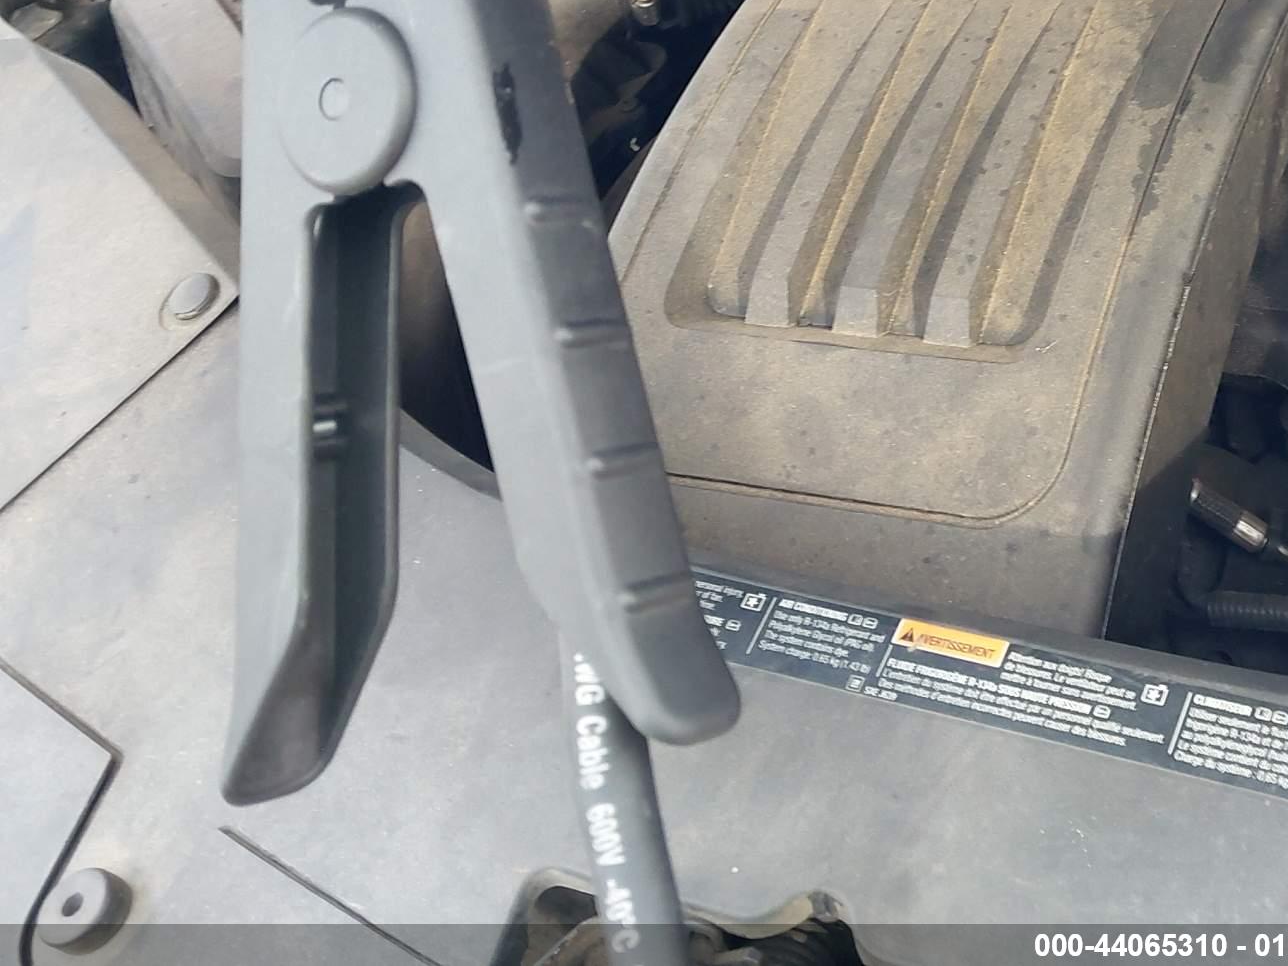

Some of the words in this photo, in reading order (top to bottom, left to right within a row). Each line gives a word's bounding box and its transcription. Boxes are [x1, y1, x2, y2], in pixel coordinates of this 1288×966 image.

[574, 652, 606, 706] WG
[576, 715, 611, 790] Cable
[585, 803, 627, 867] 600V
